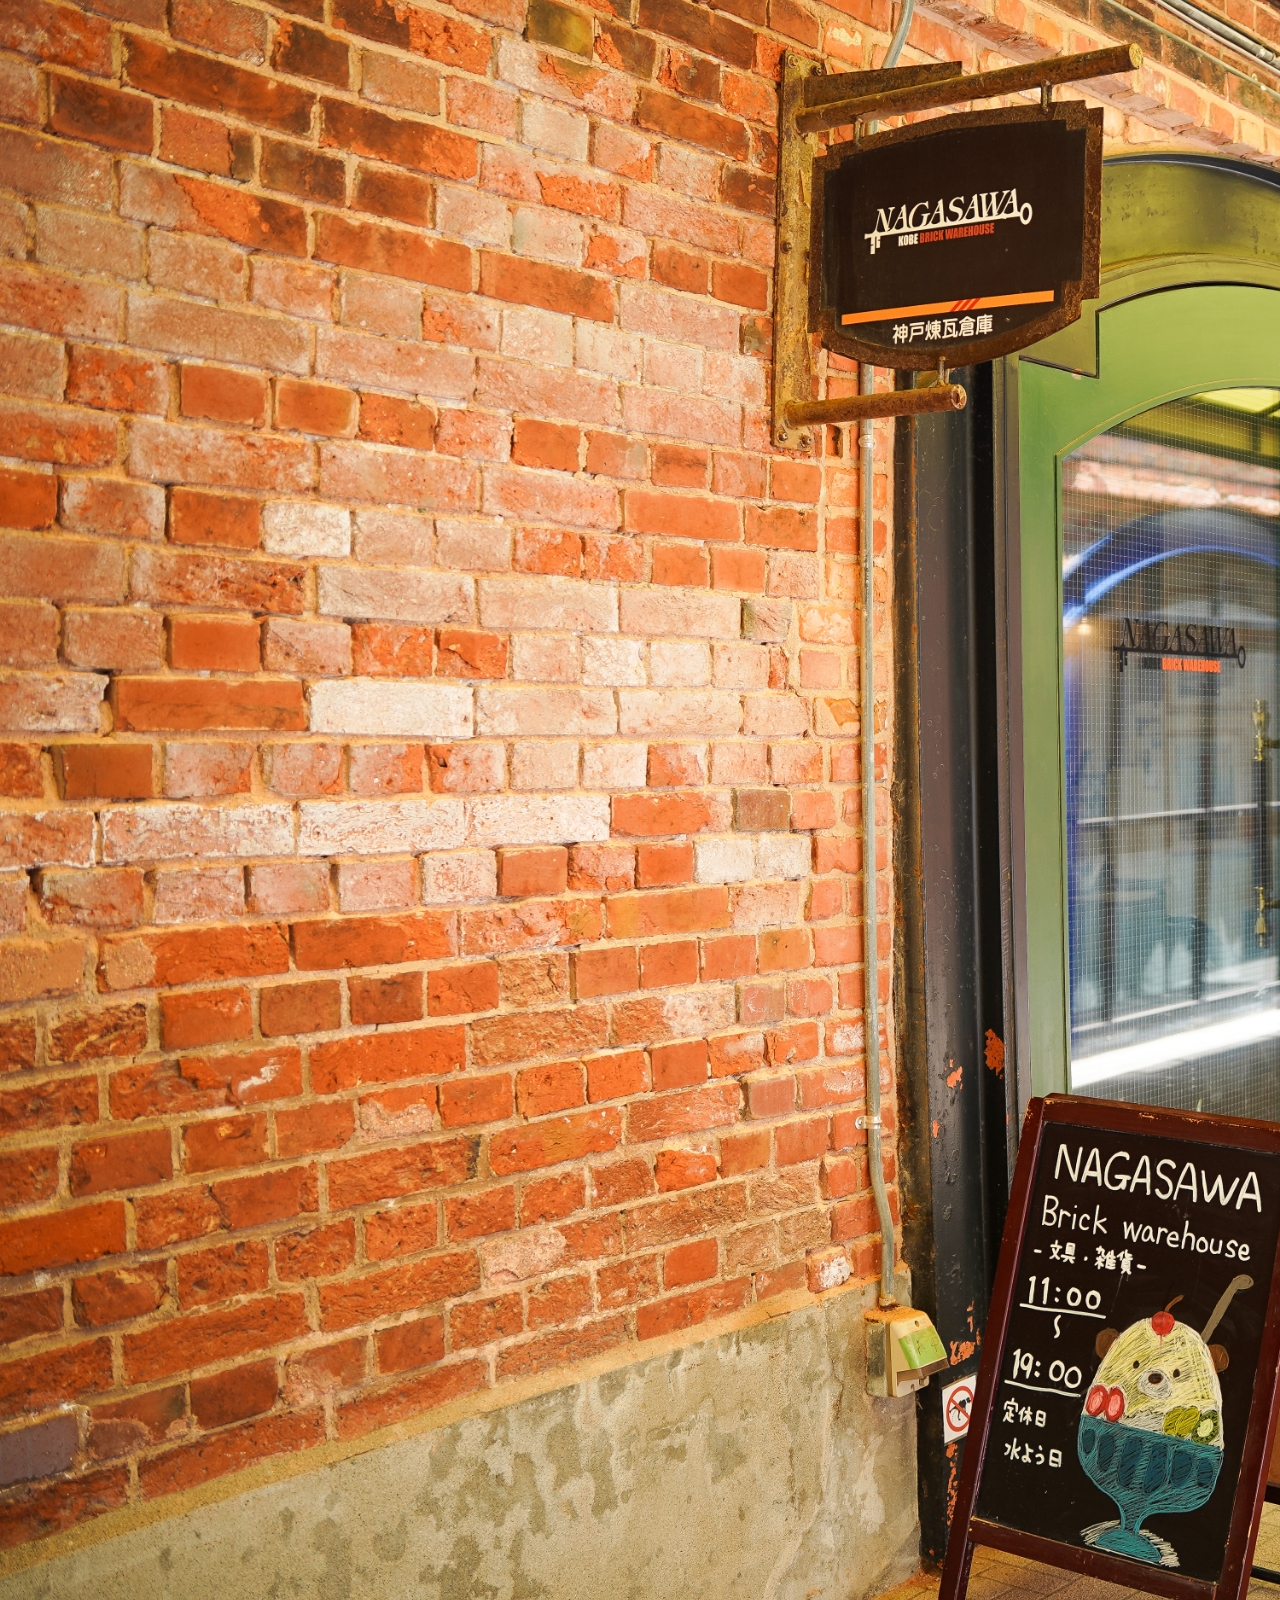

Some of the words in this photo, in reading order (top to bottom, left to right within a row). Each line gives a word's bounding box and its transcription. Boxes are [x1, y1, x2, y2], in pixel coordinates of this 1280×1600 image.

[874, 188, 1019, 232] NAGASAWA
[898, 233, 919, 247] KOBE
[919, 230, 944, 244] BRICK
[945, 222, 995, 240] WAREHOUSE
[892, 313, 994, 344] 神戸煉瓦倉庫
[1121, 617, 1237, 655] NAGASAWA
[1054, 1143, 1262, 1213] NAGASAWA
[1041, 1194, 1108, 1235] Brick
[1123, 1220, 1251, 1262] warehouse
[1027, 1275, 1102, 1310] 11:00
[1012, 1348, 1083, 1389] 19:00
[1002, 1398, 1047, 1428] 定休日
[1003, 1437, 1062, 1468] 水よう日
